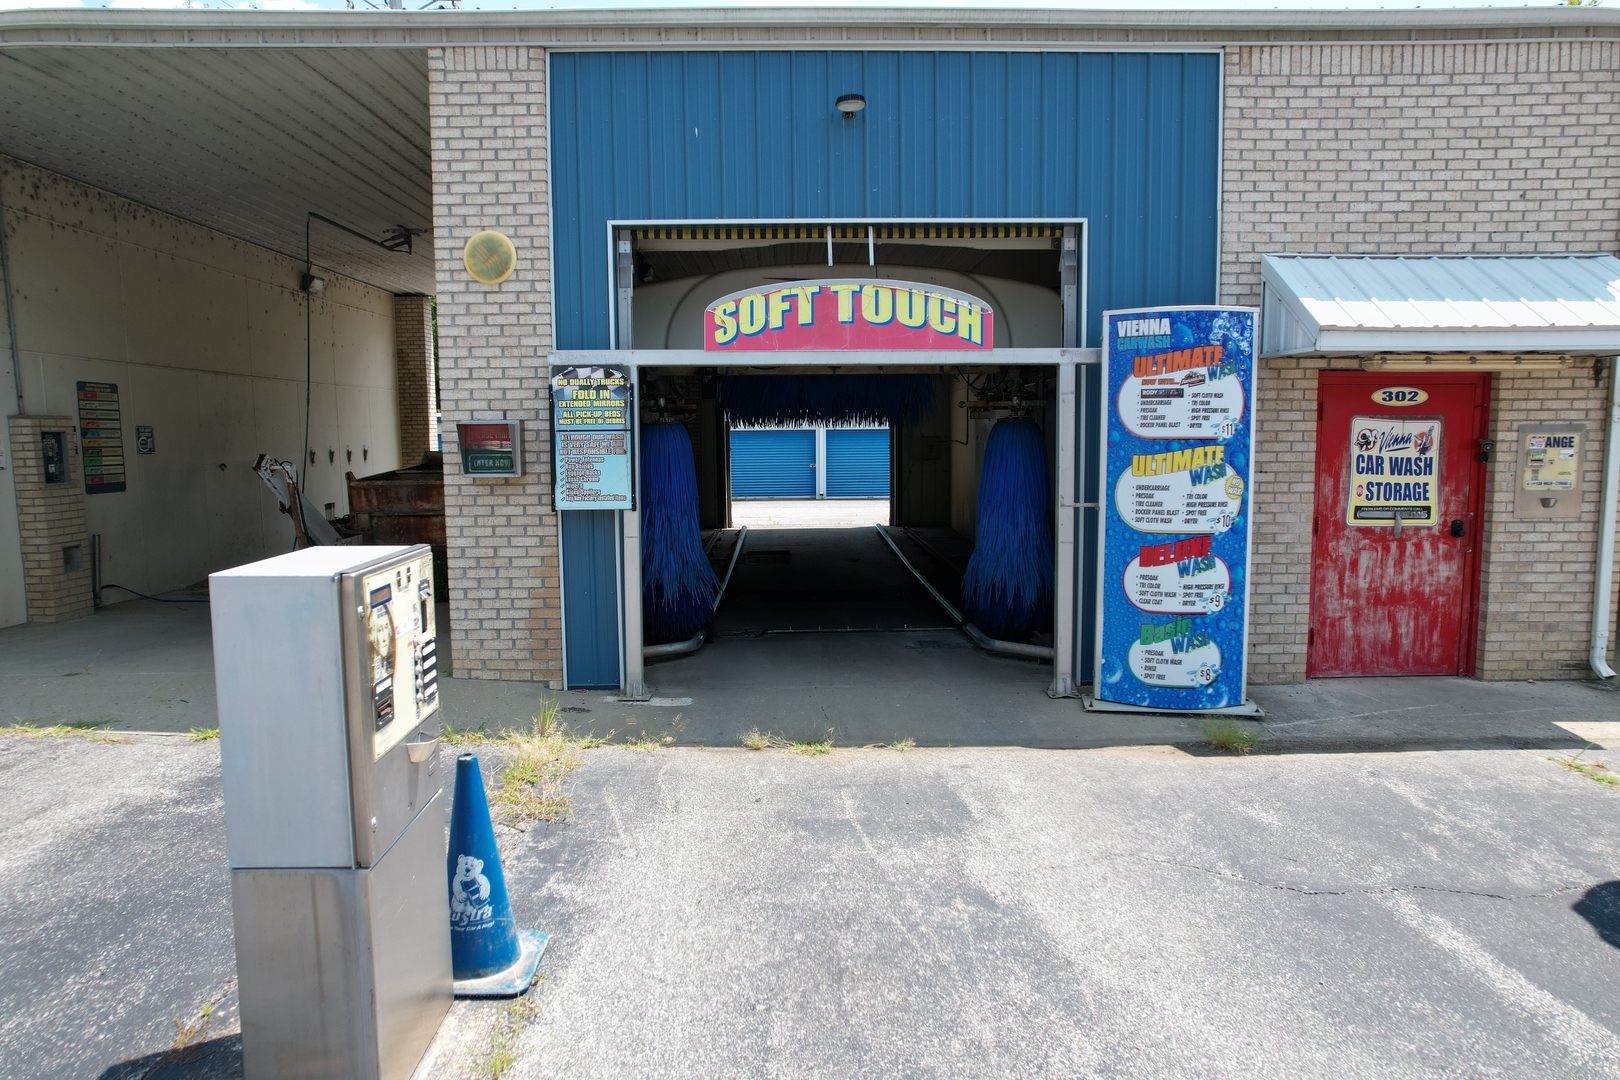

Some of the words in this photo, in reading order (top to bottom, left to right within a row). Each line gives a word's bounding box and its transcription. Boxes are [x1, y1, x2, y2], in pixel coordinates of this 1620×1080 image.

[714, 286, 822, 346] SOFT
[830, 285, 983, 346] TOUCH
[1117, 318, 1171, 338] VIENNA
[1117, 336, 1171, 350] CARWASH
[1133, 346, 1223, 377] ULTIMATE
[572, 389, 596, 399] FOLD
[600, 389, 610, 399] IN
[1382, 391, 1419, 402] 302
[1222, 423, 1233, 436] $11
[1379, 426, 1412, 454] Vienna
[1531, 436, 1575, 448] ANGE
[1132, 445, 1225, 477] ULTIMATE
[1356, 454, 1384, 475] CAR
[1389, 456, 1433, 476] WASH
[1189, 462, 1227, 488] WASH
[1365, 481, 1430, 501] STORAGE
[1216, 515, 1231, 528] $10
[1139, 536, 1212, 567] DELUXE
[1177, 554, 1216, 579] WASH
[1209, 594, 1221, 607] $9
[1140, 615, 1193, 645] Basic
[1171, 630, 1210, 655] WASH
[1200, 669, 1211, 681] $8
[450, 904, 494, 926] ustra
